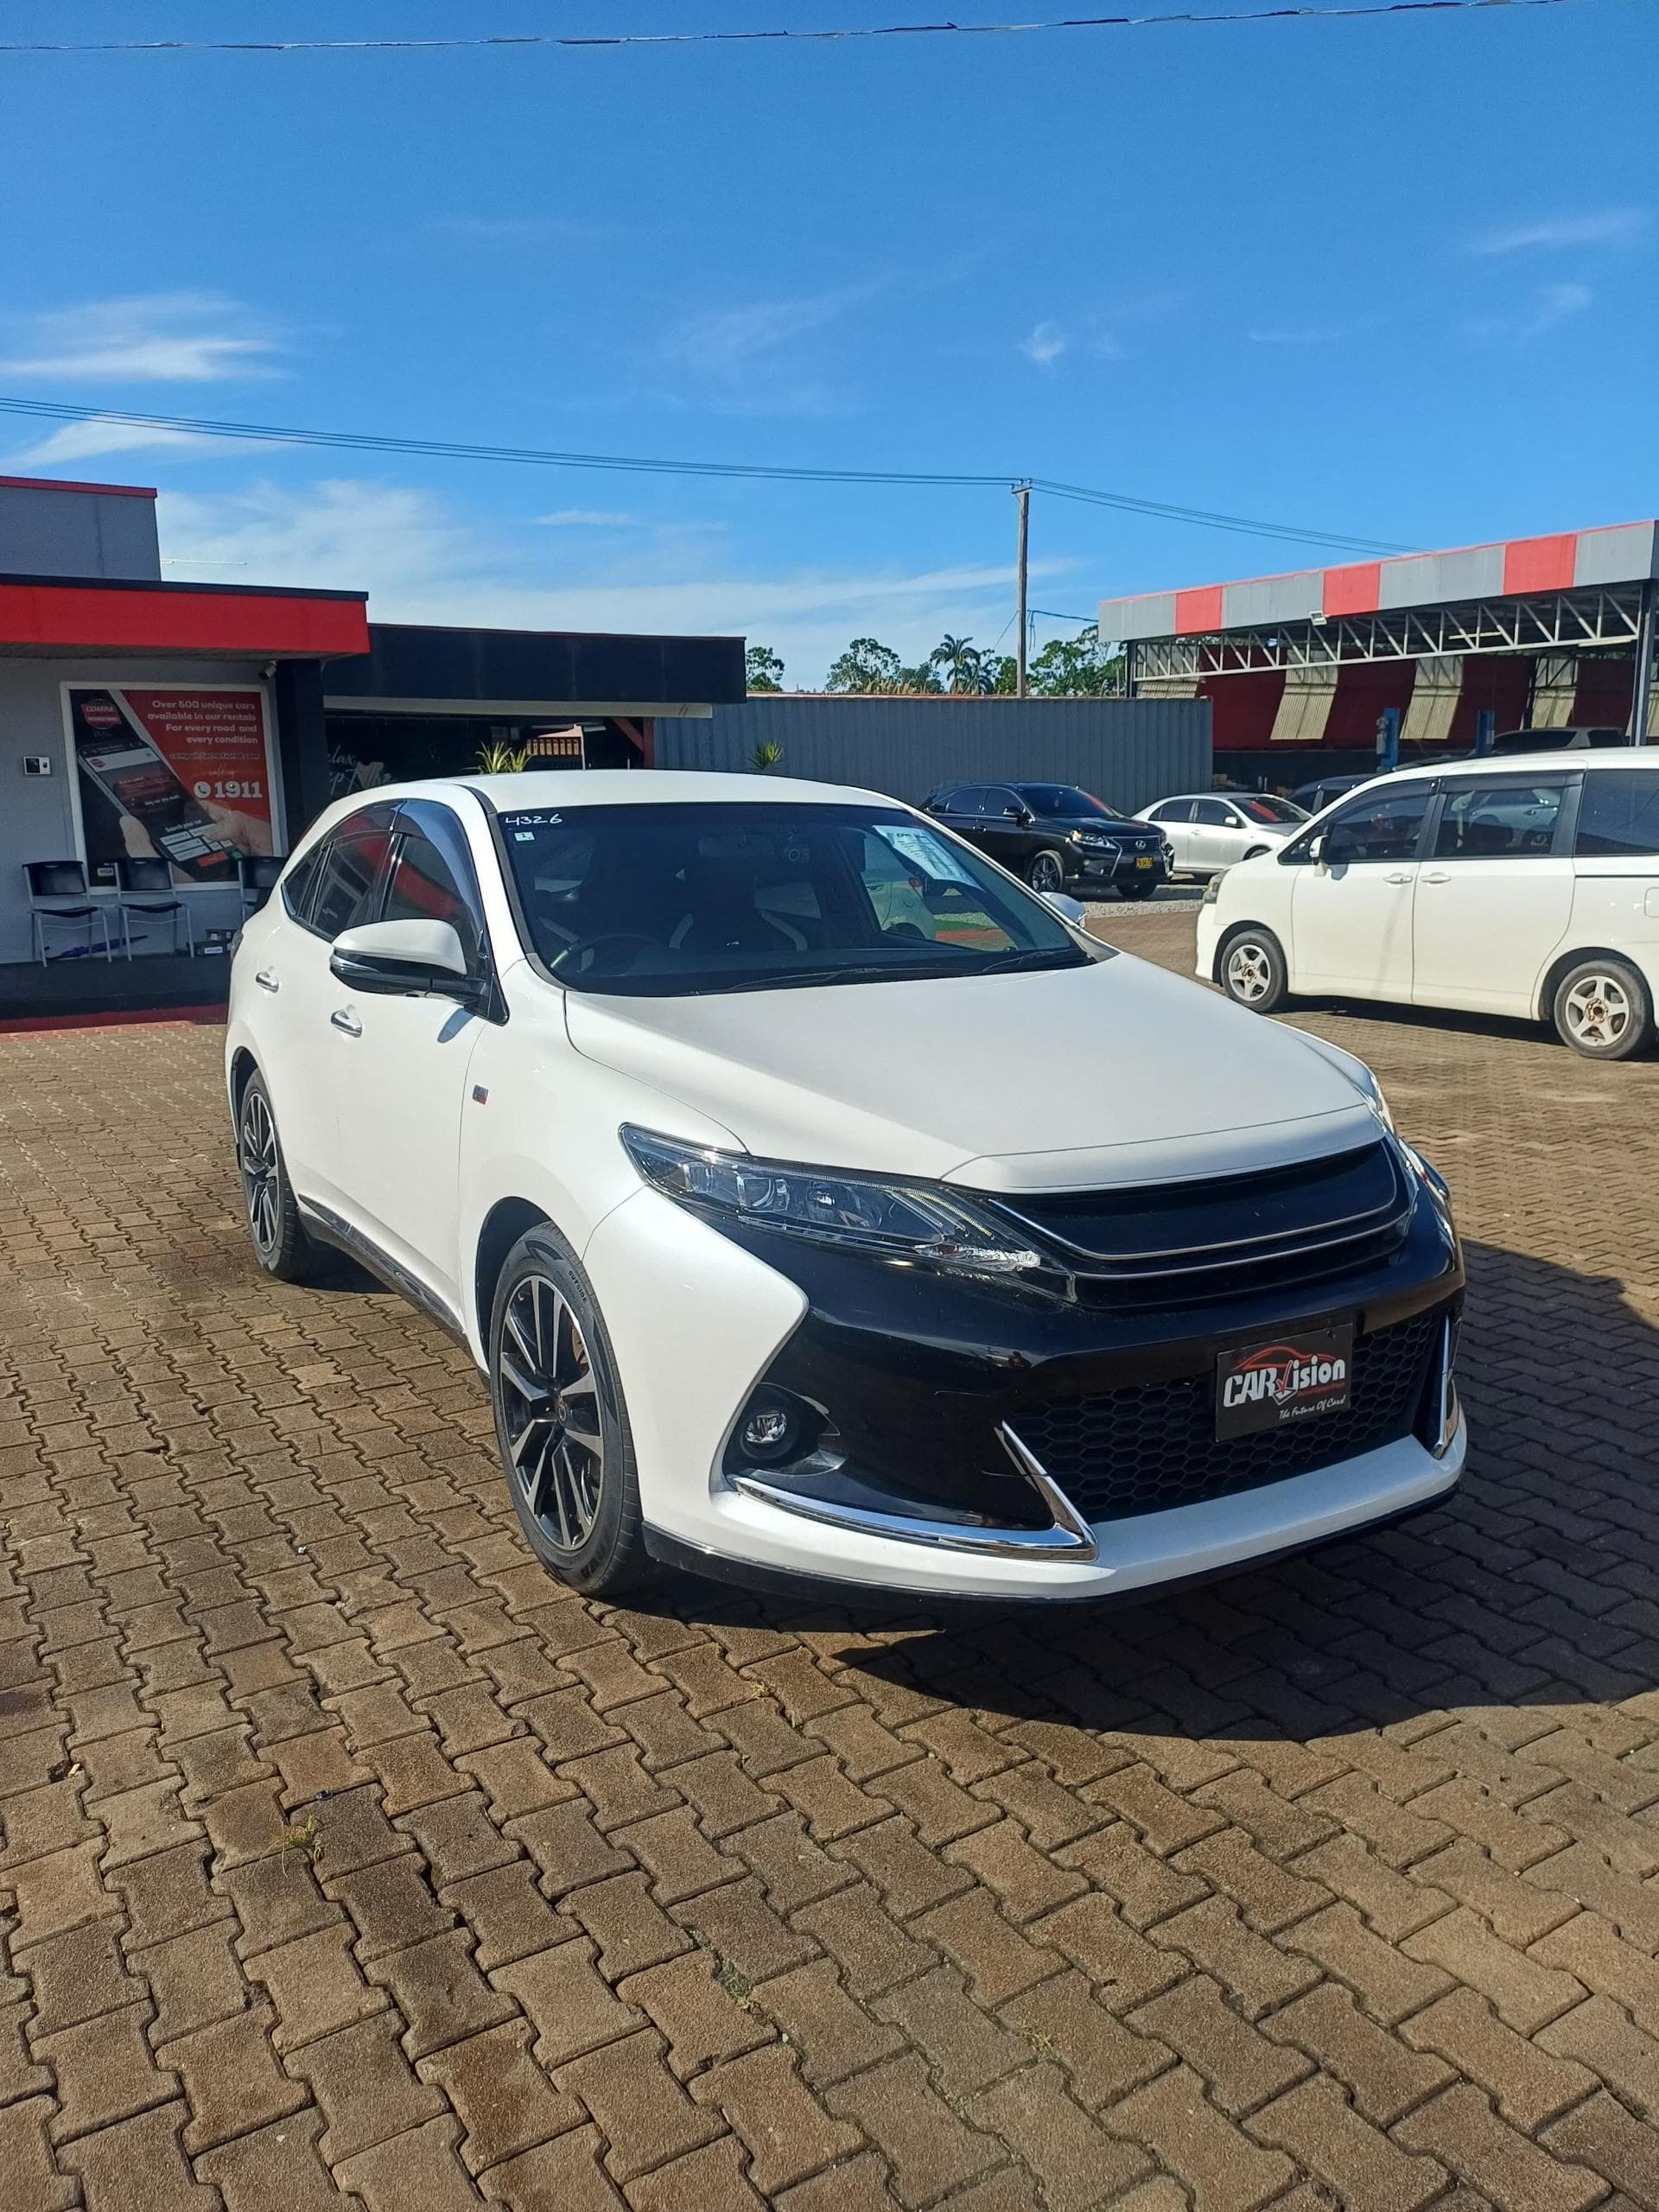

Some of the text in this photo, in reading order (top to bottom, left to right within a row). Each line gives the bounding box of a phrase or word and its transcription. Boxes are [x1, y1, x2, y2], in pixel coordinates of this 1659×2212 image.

[152, 700, 256, 710] Over 500 unique cars
[147, 711, 193, 720] available
[223, 712, 257, 721] rentals
[184, 725, 213, 734] every
[238, 724, 257, 733] and
[186, 735, 258, 745] every condition
[214, 780, 263, 798] 1911
[505, 813, 563, 826] 4326
[1279, 1408, 1291, 1420] The
[1316, 1399, 1327, 1412] Of
